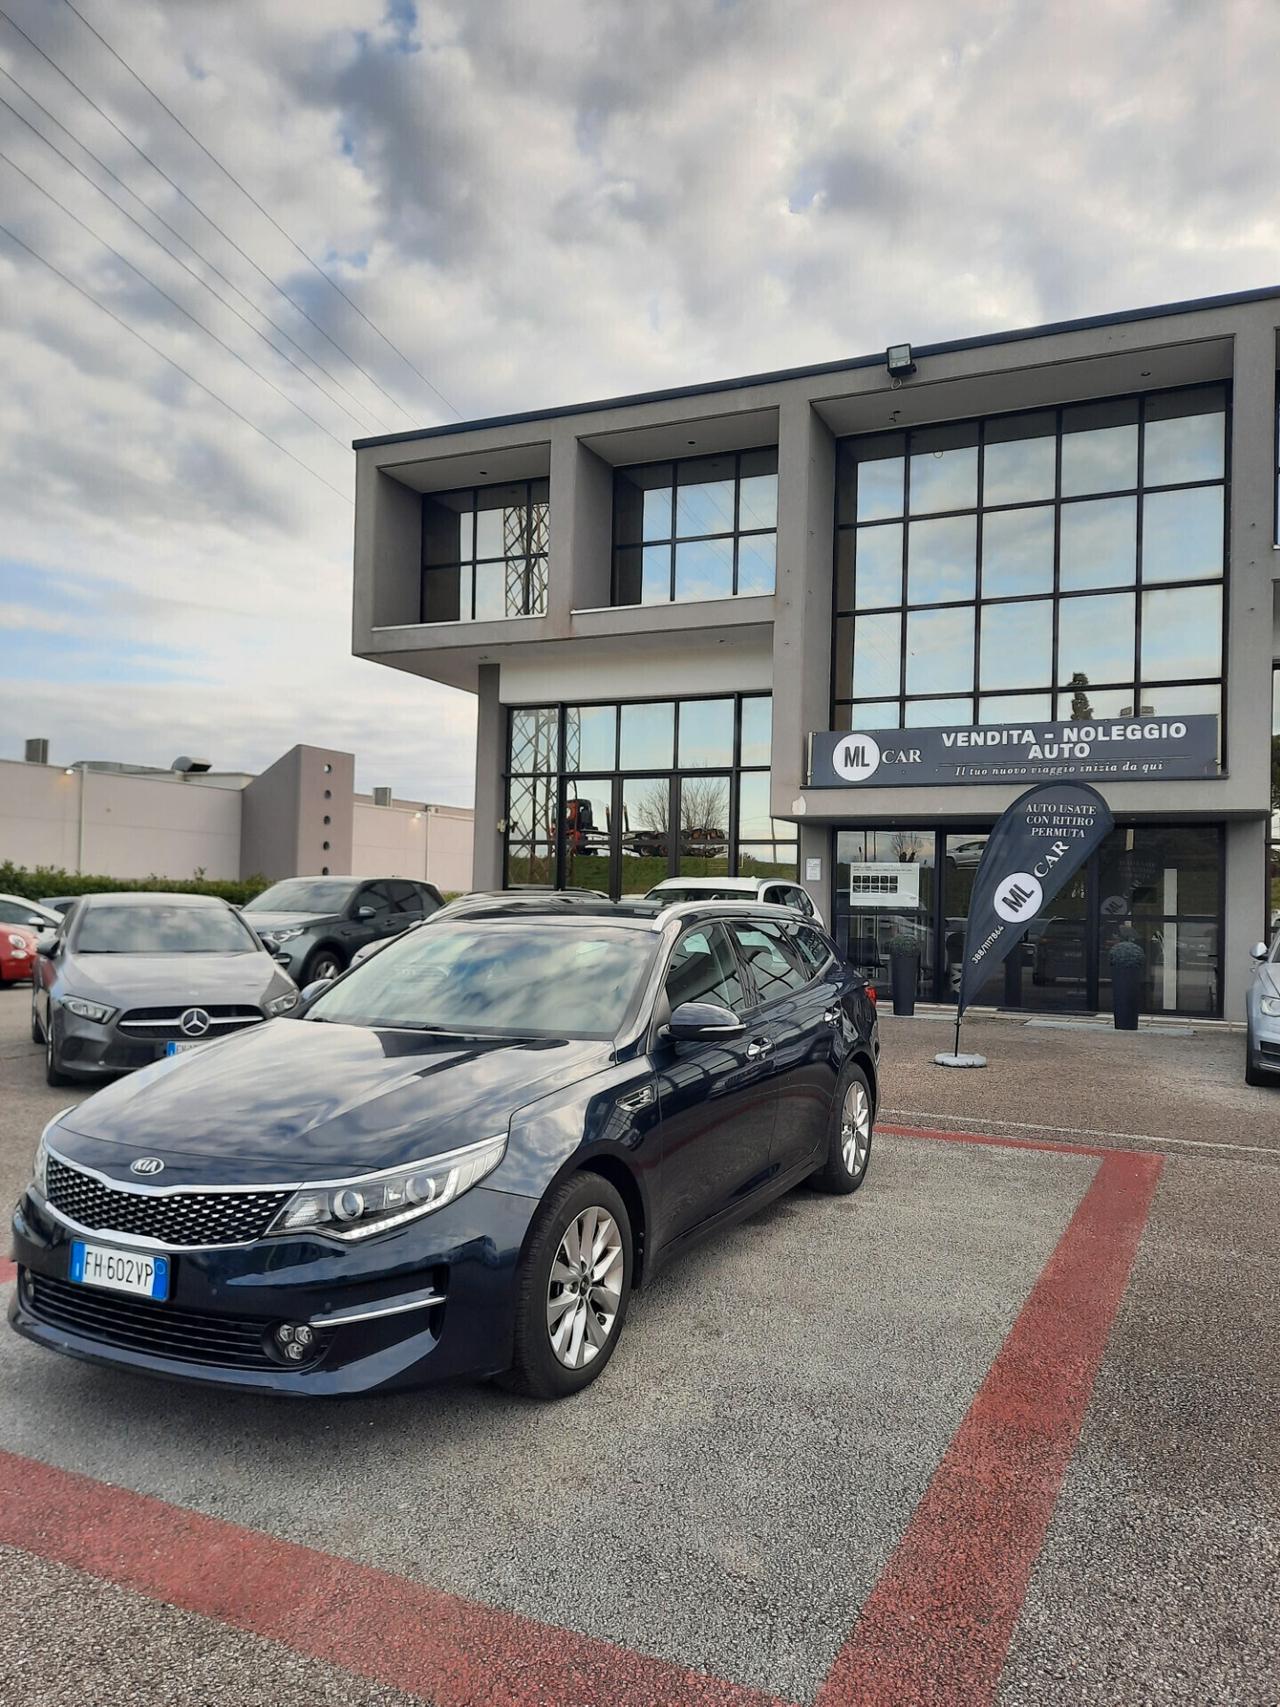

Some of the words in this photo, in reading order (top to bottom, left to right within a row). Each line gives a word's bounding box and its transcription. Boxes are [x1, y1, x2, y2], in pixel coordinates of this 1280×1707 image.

[942, 729, 1037, 747] VENDITA
[1063, 722, 1187, 742] NOLEGGIO
[844, 745, 870, 768] ML
[881, 749, 923, 764] CAR
[1028, 742, 1091, 760] AUTO
[955, 765, 966, 776] Il
[969, 766, 988, 776] tuo
[992, 766, 1027, 775] nuovo
[1031, 763, 1075, 776] viaggio
[1080, 762, 1118, 773] inizia
[1122, 761, 1137, 771] da
[1142, 761, 1163, 773] qui
[1025, 803, 1057, 814] AUTO
[1059, 804, 1097, 815] USATE
[1026, 815, 1050, 825] CON
[1052, 816, 1094, 827] RITIRO
[1031, 827, 1086, 838] PERMUTA
[1001, 883, 1035, 914] ML
[1034, 840, 1071, 878] CAR
[134, 1159, 159, 1172] KIA
